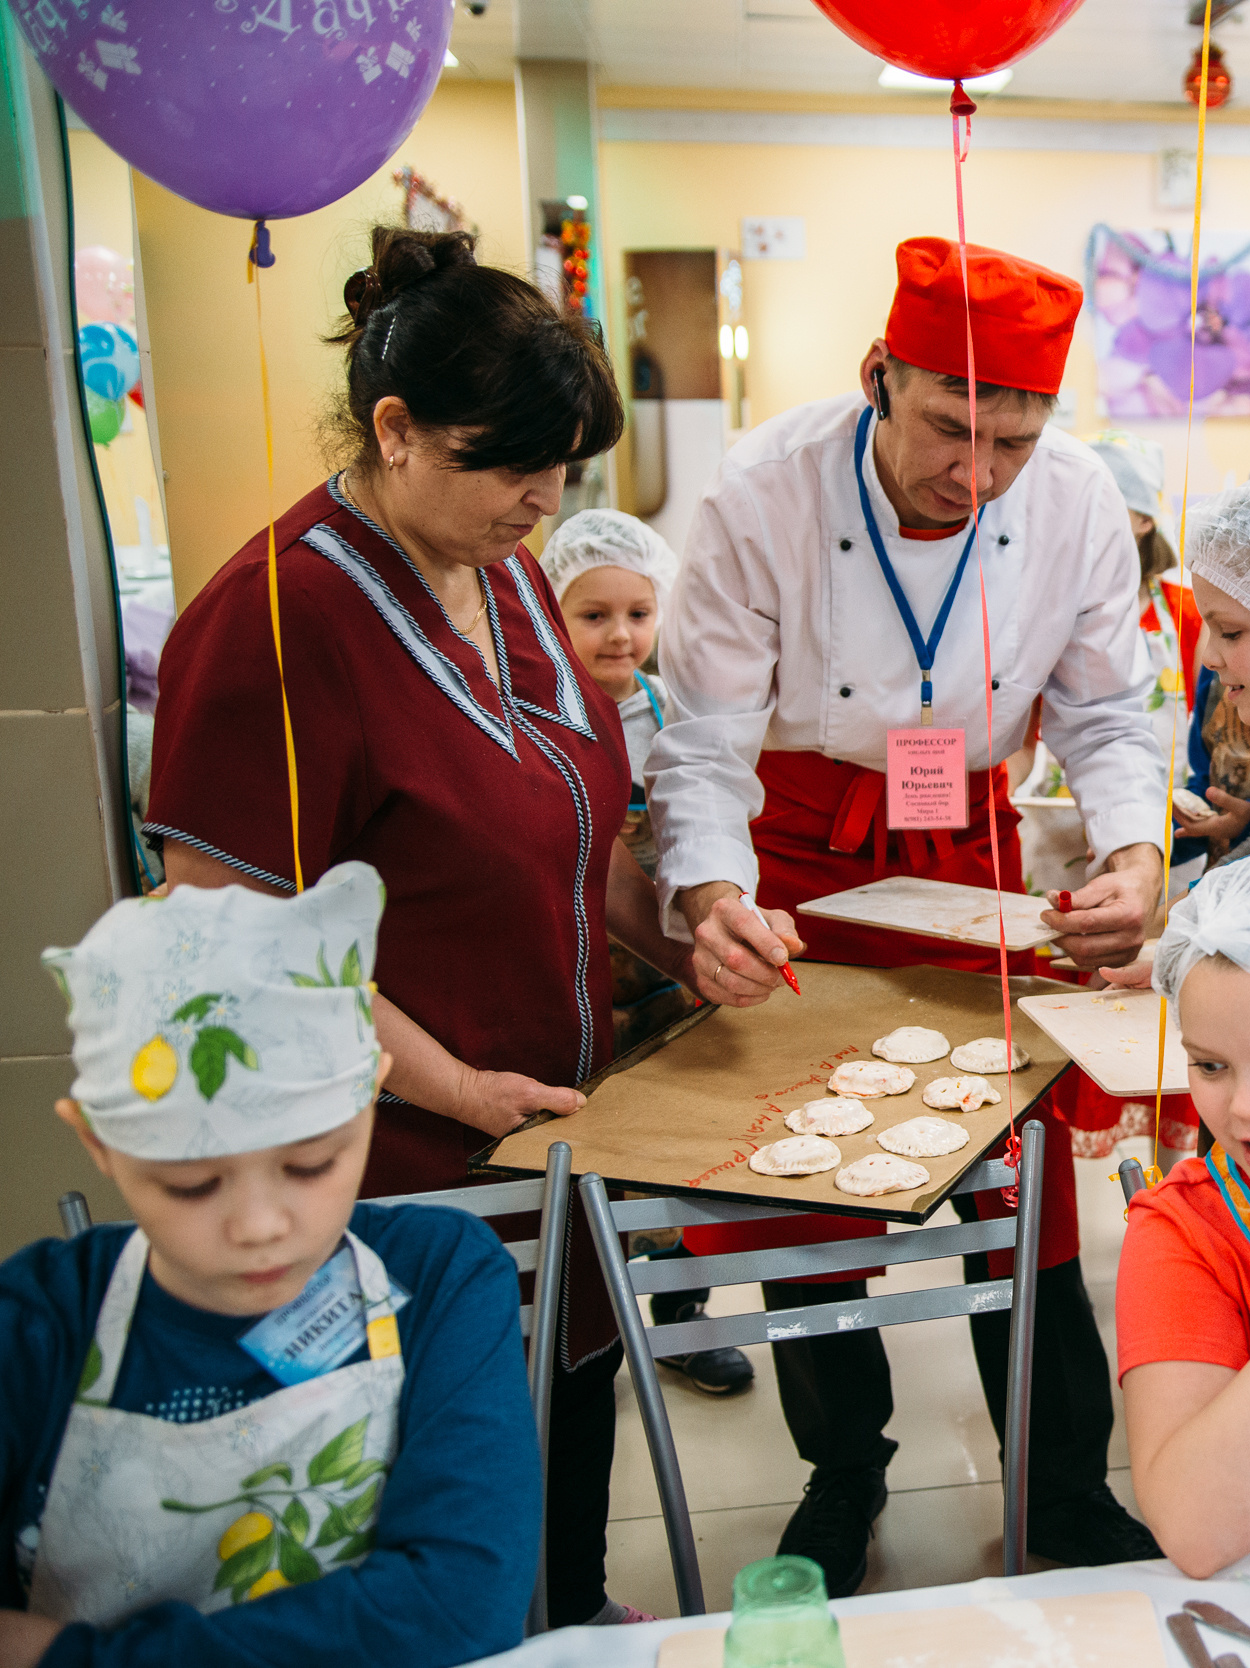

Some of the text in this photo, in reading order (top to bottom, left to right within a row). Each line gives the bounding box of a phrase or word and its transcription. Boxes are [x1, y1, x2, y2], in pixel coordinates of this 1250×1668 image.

[896, 738, 957, 747] ПРОФЕССОР
[910, 766, 944, 777] Юрий
[901, 780, 953, 792] Юрьевич
